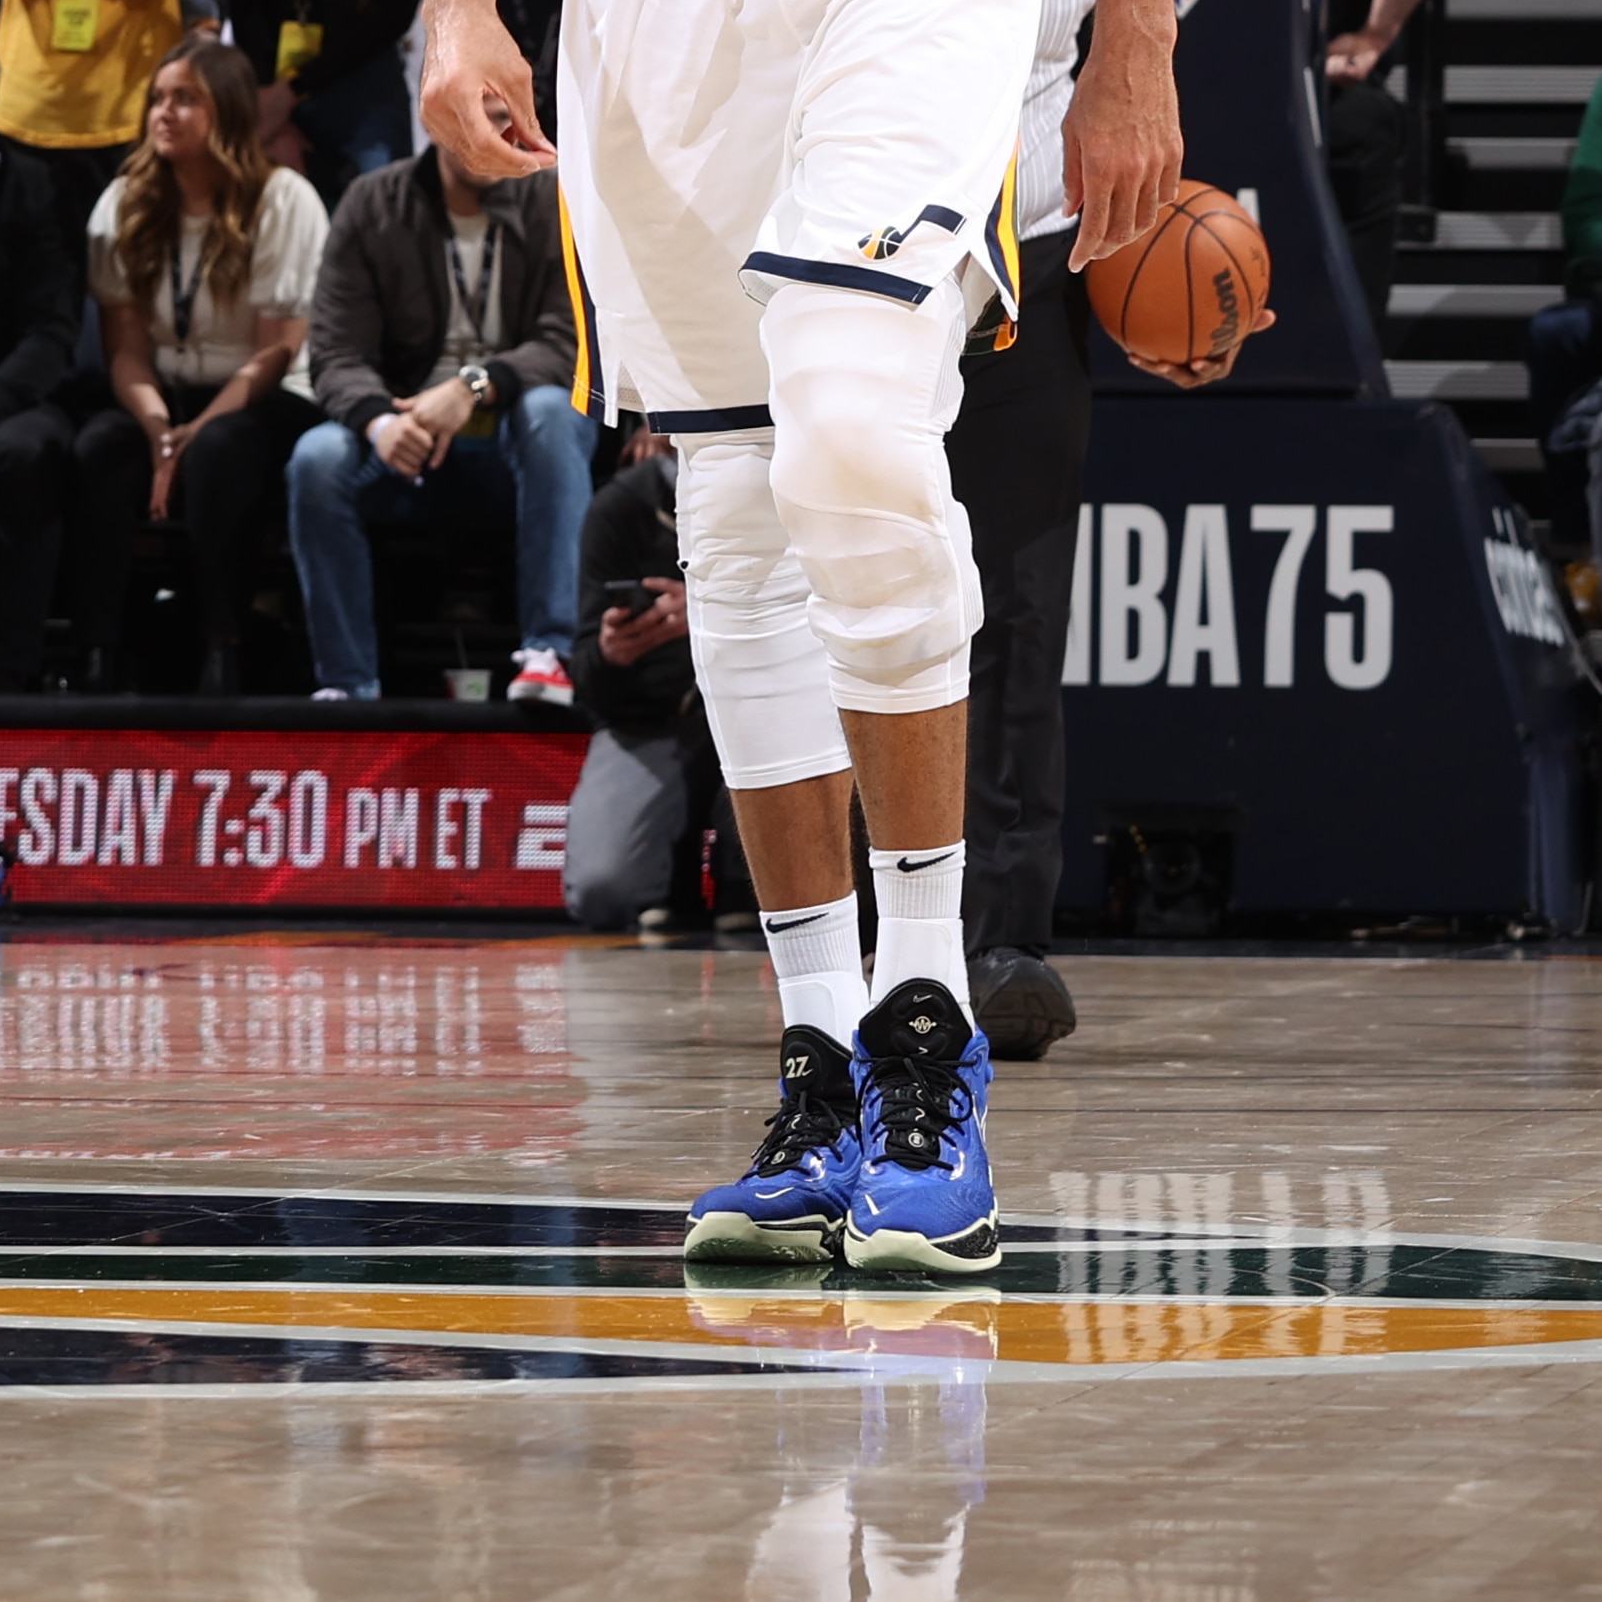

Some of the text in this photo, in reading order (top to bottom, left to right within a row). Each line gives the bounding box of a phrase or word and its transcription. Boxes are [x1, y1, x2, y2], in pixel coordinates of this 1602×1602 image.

[1250, 504, 1395, 690] 75
[193, 768, 328, 869] 7:30
[344, 787, 420, 870] PM
[434, 787, 493, 870] ET
[785, 1055, 810, 1079] 27
